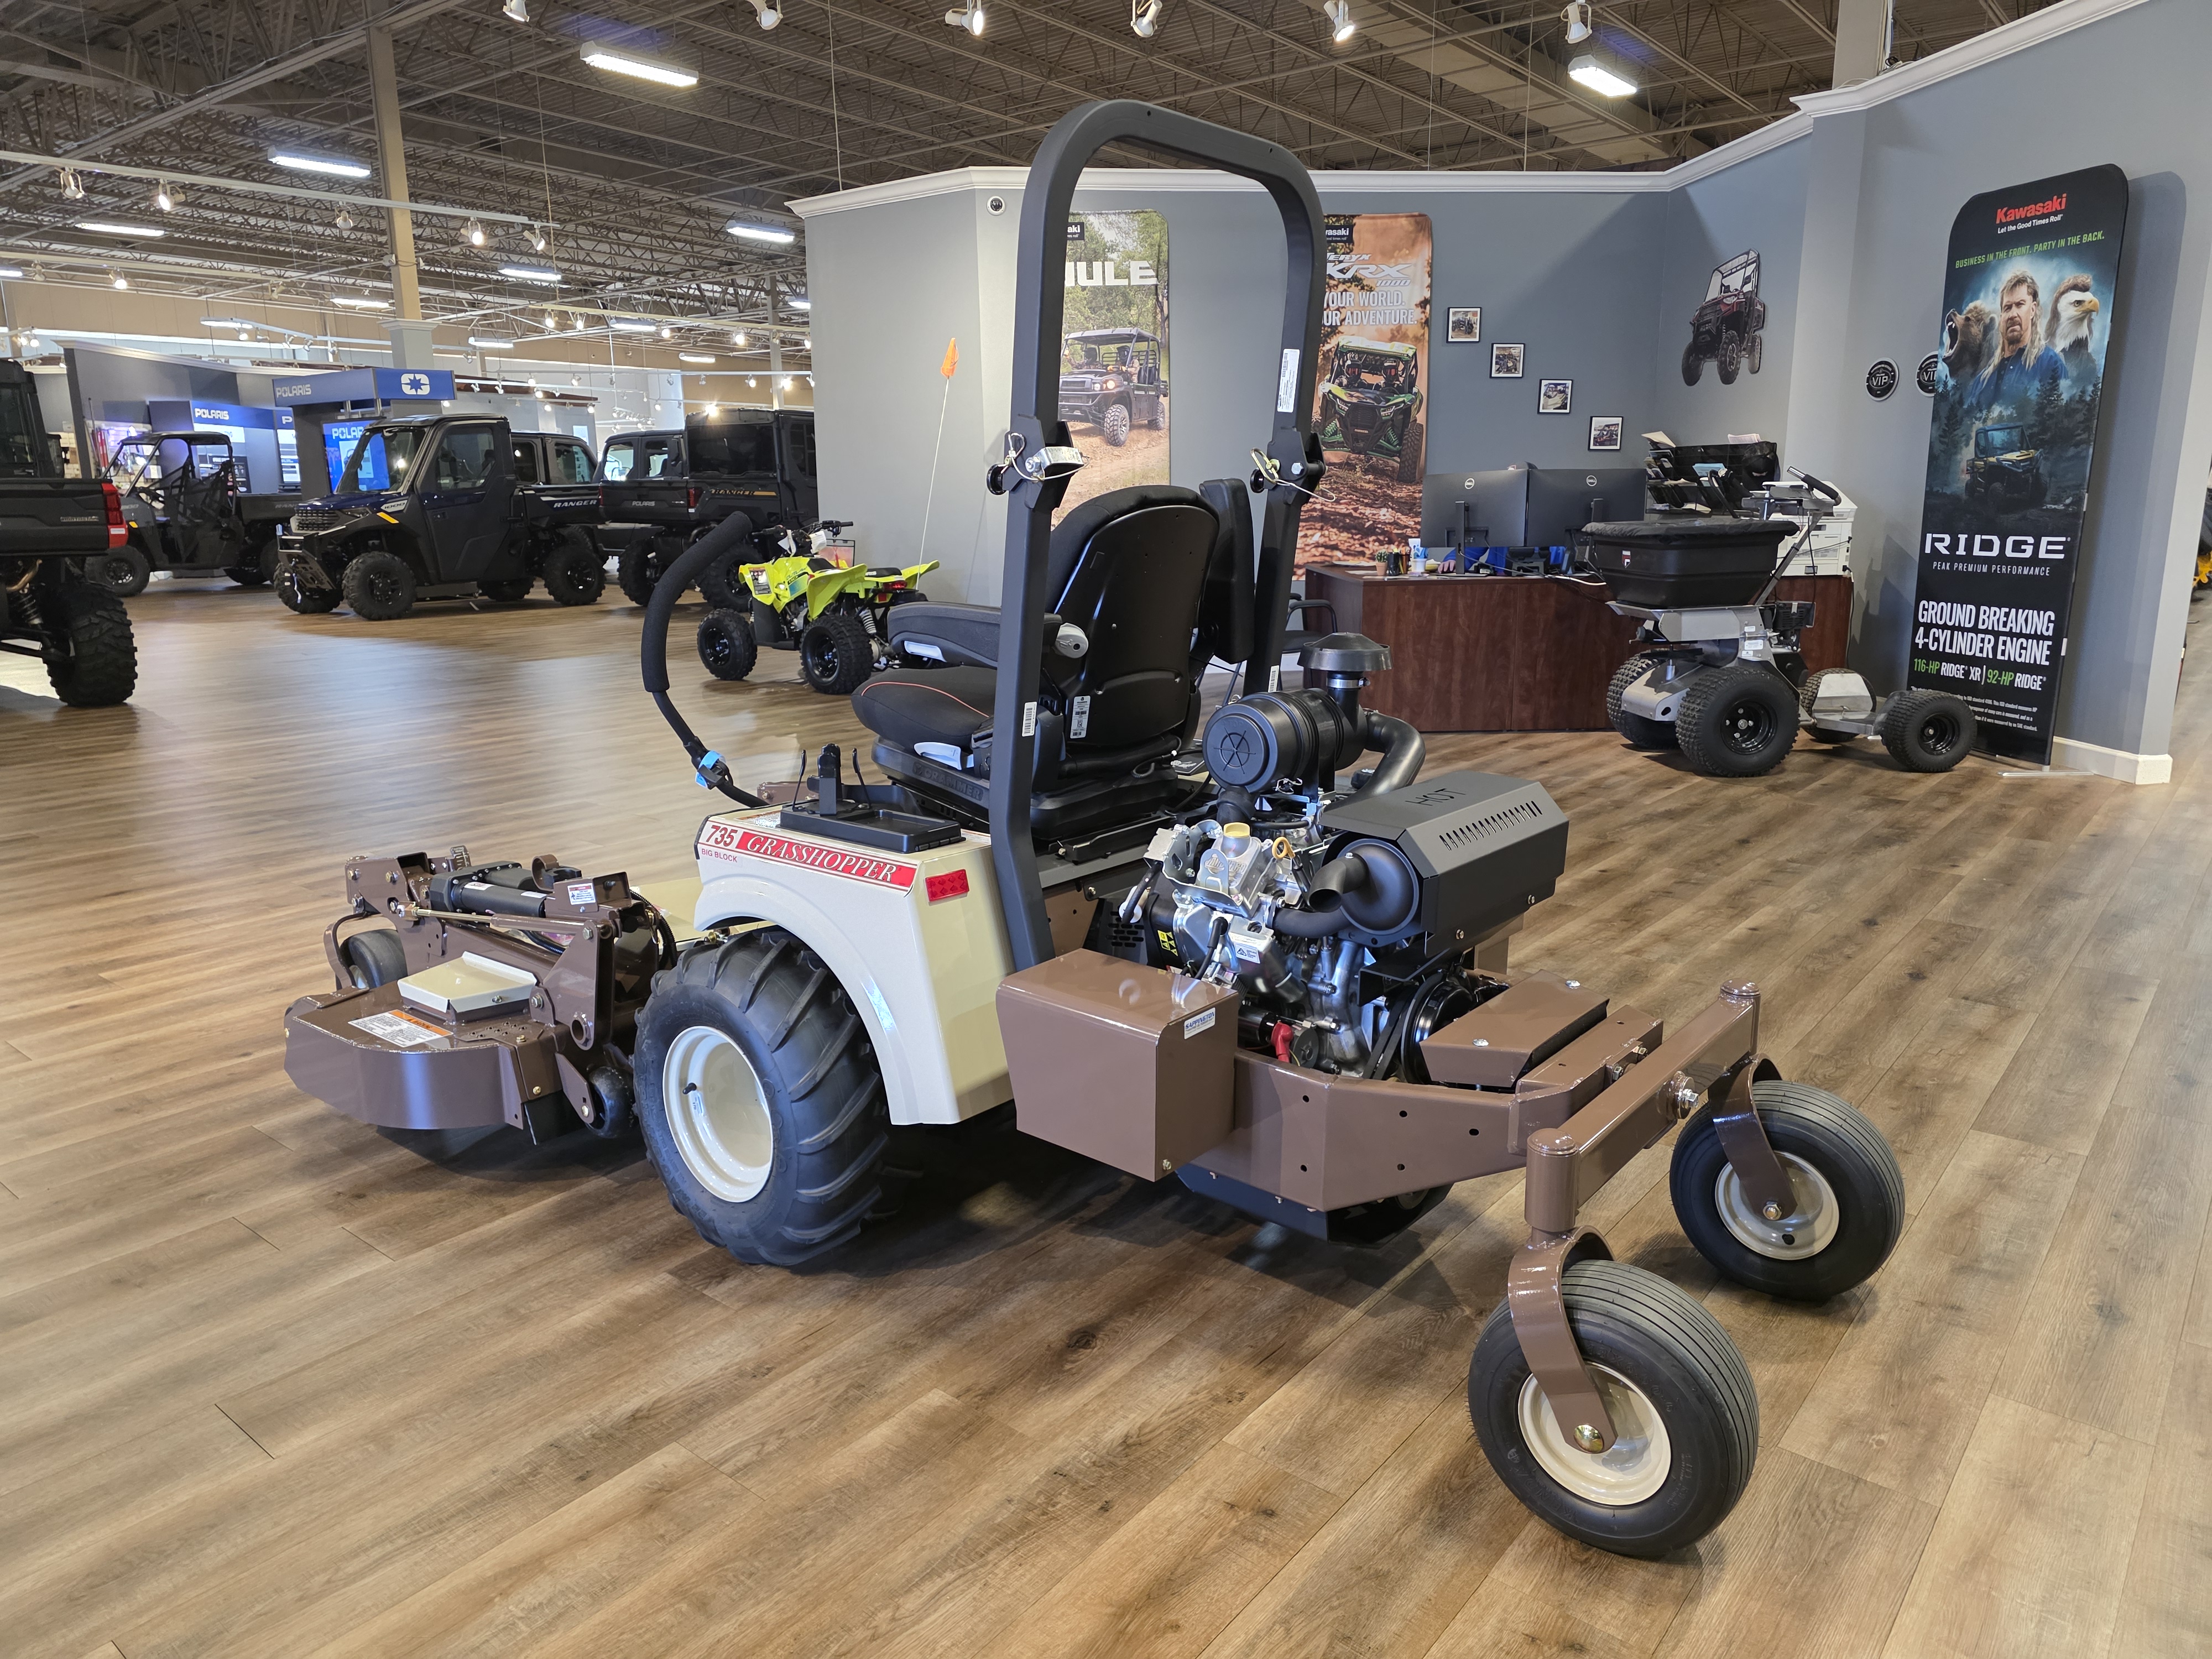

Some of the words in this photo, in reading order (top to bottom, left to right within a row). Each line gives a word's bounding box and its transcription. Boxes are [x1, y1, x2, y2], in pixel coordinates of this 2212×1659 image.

[1996, 193, 2067, 224] Kawasaki
[2017, 221, 2031, 229] Good
[2032, 218, 2049, 226] Times
[1955, 255, 1985, 269] BUSINESS
[1987, 253, 1994, 262] IN
[1995, 249, 2007, 260] THE
[2008, 245, 2032, 258] FRONT.
[2033, 240, 2057, 254] PARTY
[2058, 238, 2065, 248] IN
[2067, 235, 2081, 247] THE
[2082, 230, 2105, 243] BACK.
[1327, 263, 1413, 279] KRX
[1359, 291, 1406, 307] WORLD.
[1322, 311, 1340, 326] UR
[1344, 309, 1418, 326] ADVENTURE.
[1872, 375, 1888, 386] VIP
[276, 384, 311, 398] POLARIS
[194, 408, 229, 420] POLARIS
[553, 500, 598, 508] RANGER
[1924, 533, 2067, 559] RIDGE
[1933, 561, 1950, 571] PEAK
[1954, 563, 1988, 573] PREMIUM
[1992, 565, 2050, 576] PERFORMANCE
[1918, 600, 1976, 628] GROUND
[1978, 606, 2055, 636] BREAKING
[1914, 627, 1995, 658] 4-CYLINDER
[1996, 636, 2052, 665] ENGINE
[1914, 658, 1940, 674] 116-HP
[1940, 662, 1965, 679] RIDGE
[1969, 667, 1981, 681] XR
[1987, 669, 2014, 686] 92-HP
[2014, 673, 2044, 691] RIDGE
[706, 825, 738, 847] 735
[701, 848, 713, 857] BIG
[714, 852, 738, 863] BLOCK
[747, 836, 897, 883] GRASSHOPPER
[1185, 1011, 1214, 1029] SAPPINGTON
